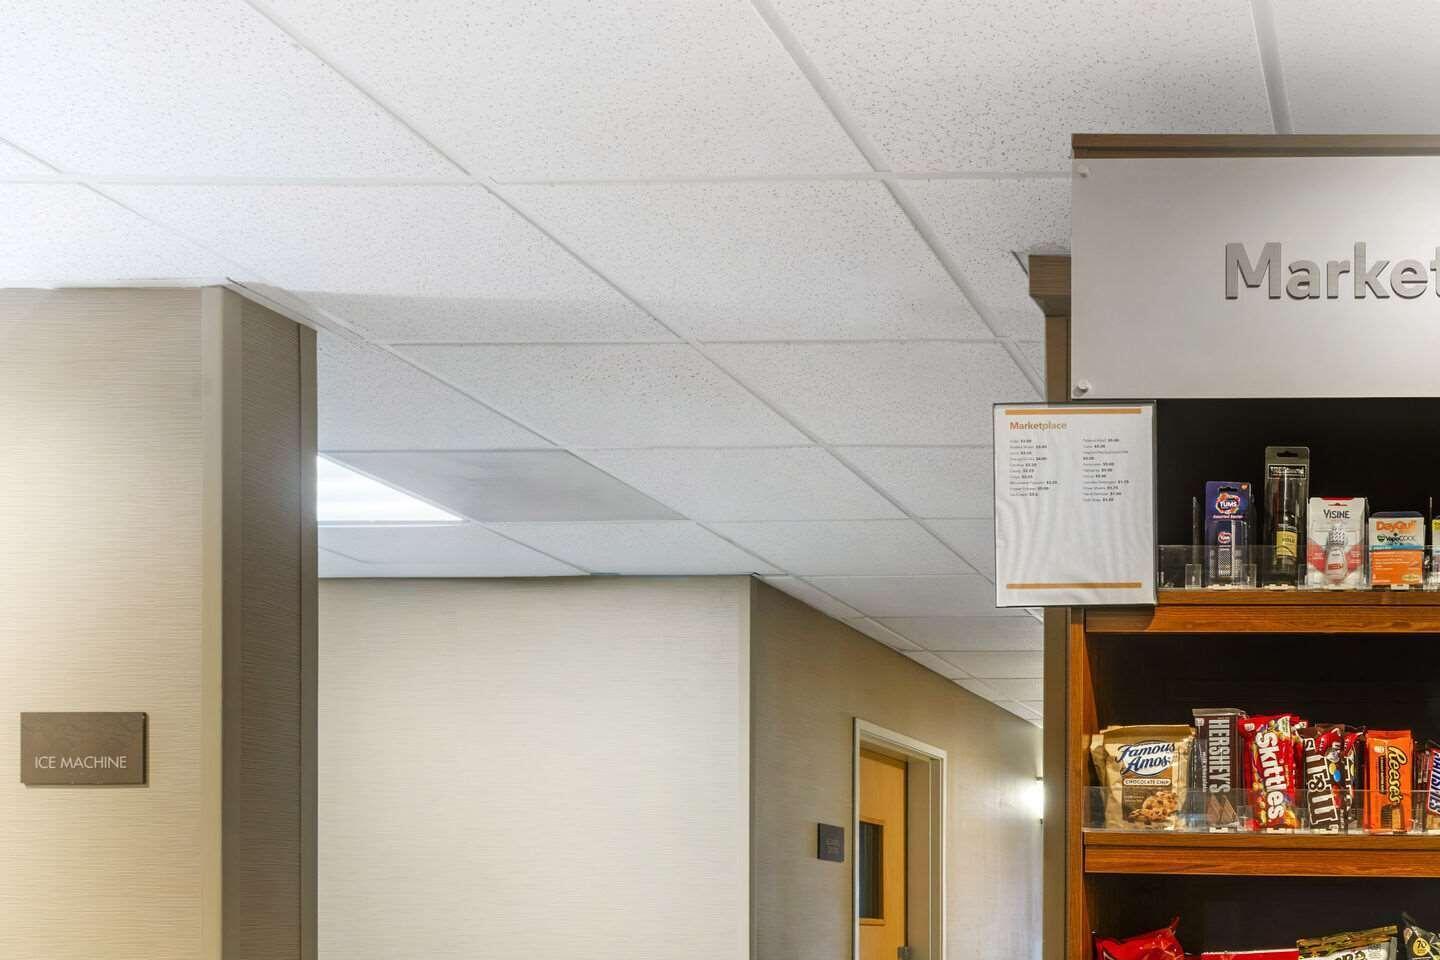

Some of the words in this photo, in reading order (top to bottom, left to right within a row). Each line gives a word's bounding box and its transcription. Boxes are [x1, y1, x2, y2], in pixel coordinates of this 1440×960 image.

[1009, 421, 1068, 431] Marketplace
[1323, 509, 1351, 519] VISINE
[1376, 521, 1417, 531] DayQuil
[34, 756, 56, 769] ICE
[60, 756, 127, 769] MACHINE
[1115, 743, 1175, 763] Famous
[1209, 720, 1231, 793] HERSHEY'S
[1120, 755, 1168, 775] Amos
[1387, 746, 1408, 804] Reese's
[1255, 732, 1287, 820] Skittles
